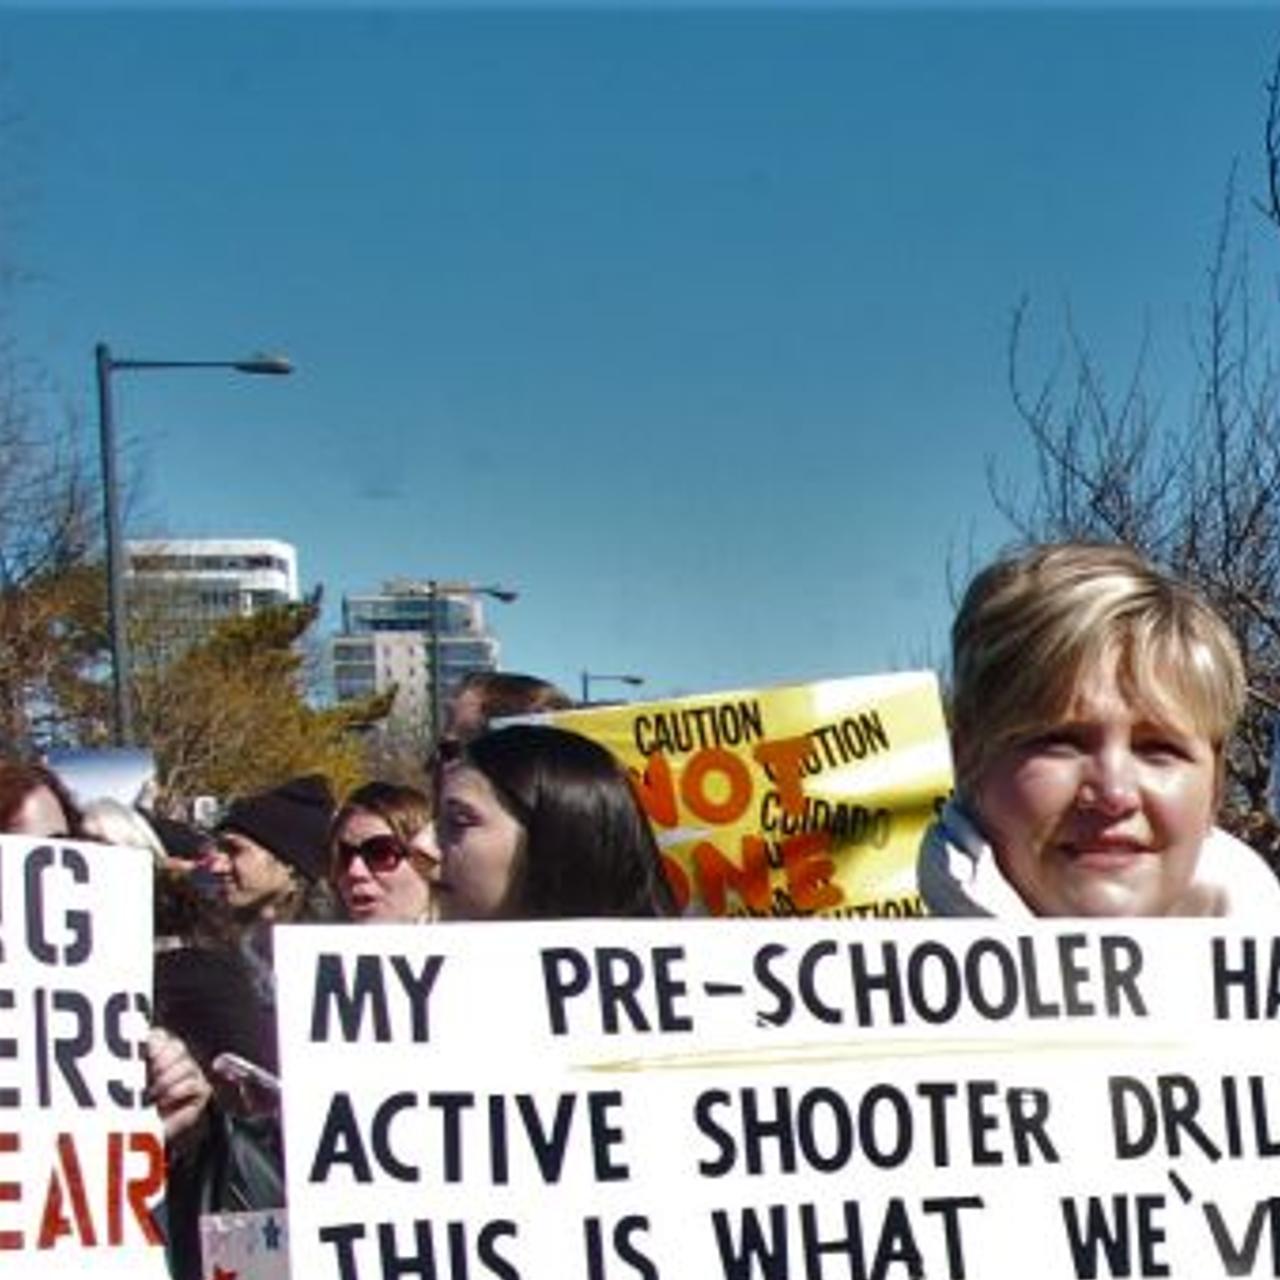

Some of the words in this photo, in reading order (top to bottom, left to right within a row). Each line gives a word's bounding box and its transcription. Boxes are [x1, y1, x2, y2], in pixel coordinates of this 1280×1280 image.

[633, 700, 763, 758] CAUTION
[763, 709, 890, 781] UTION
[0, 844, 94, 966] G
[310, 953, 445, 1043] MY
[541, 934, 1147, 1035] PRE-SCHOOLER
[309, 1091, 630, 1185] ACTIVE
[693, 1081, 1060, 1178] SHOOTER
